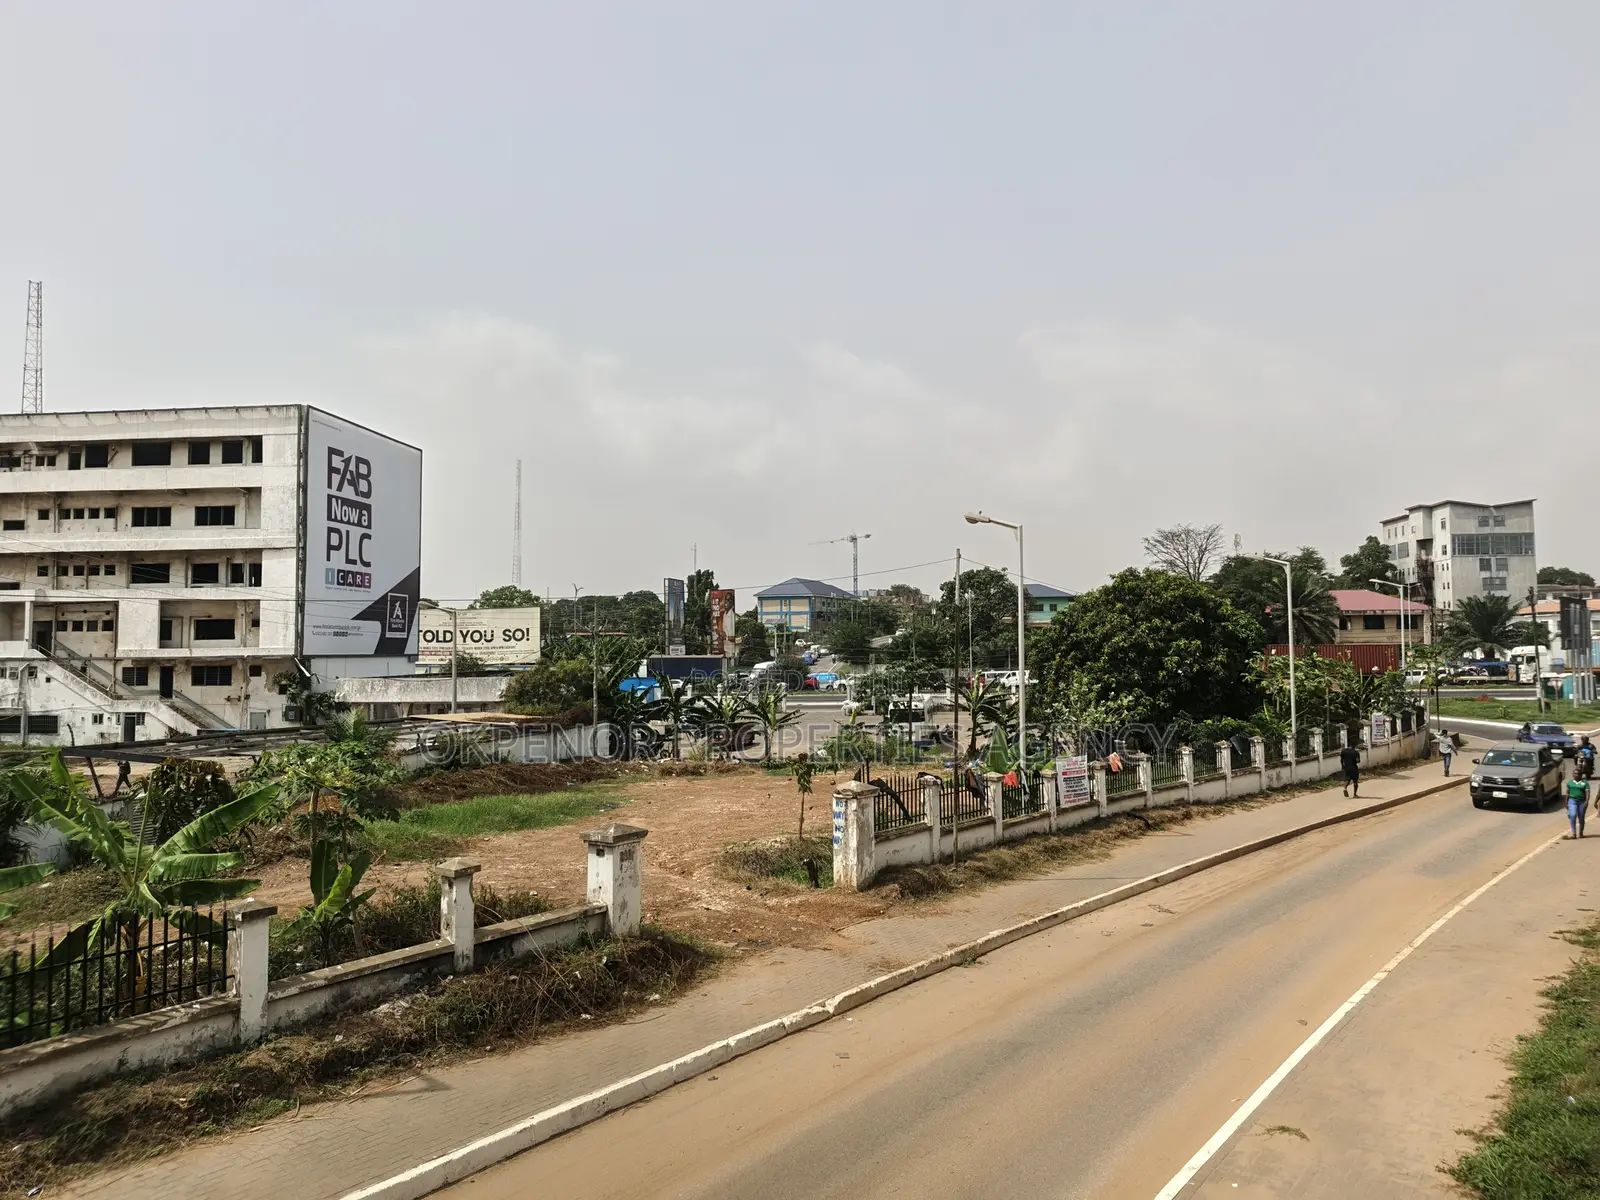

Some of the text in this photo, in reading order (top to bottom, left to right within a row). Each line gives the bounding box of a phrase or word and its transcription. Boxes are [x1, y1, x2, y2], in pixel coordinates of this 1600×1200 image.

[327, 446, 372, 499] FAB
[331, 497, 368, 526] Now a
[326, 526, 372, 568] PLC
[338, 571, 370, 586] CARE
[419, 627, 530, 643] OLD YOU SO!
